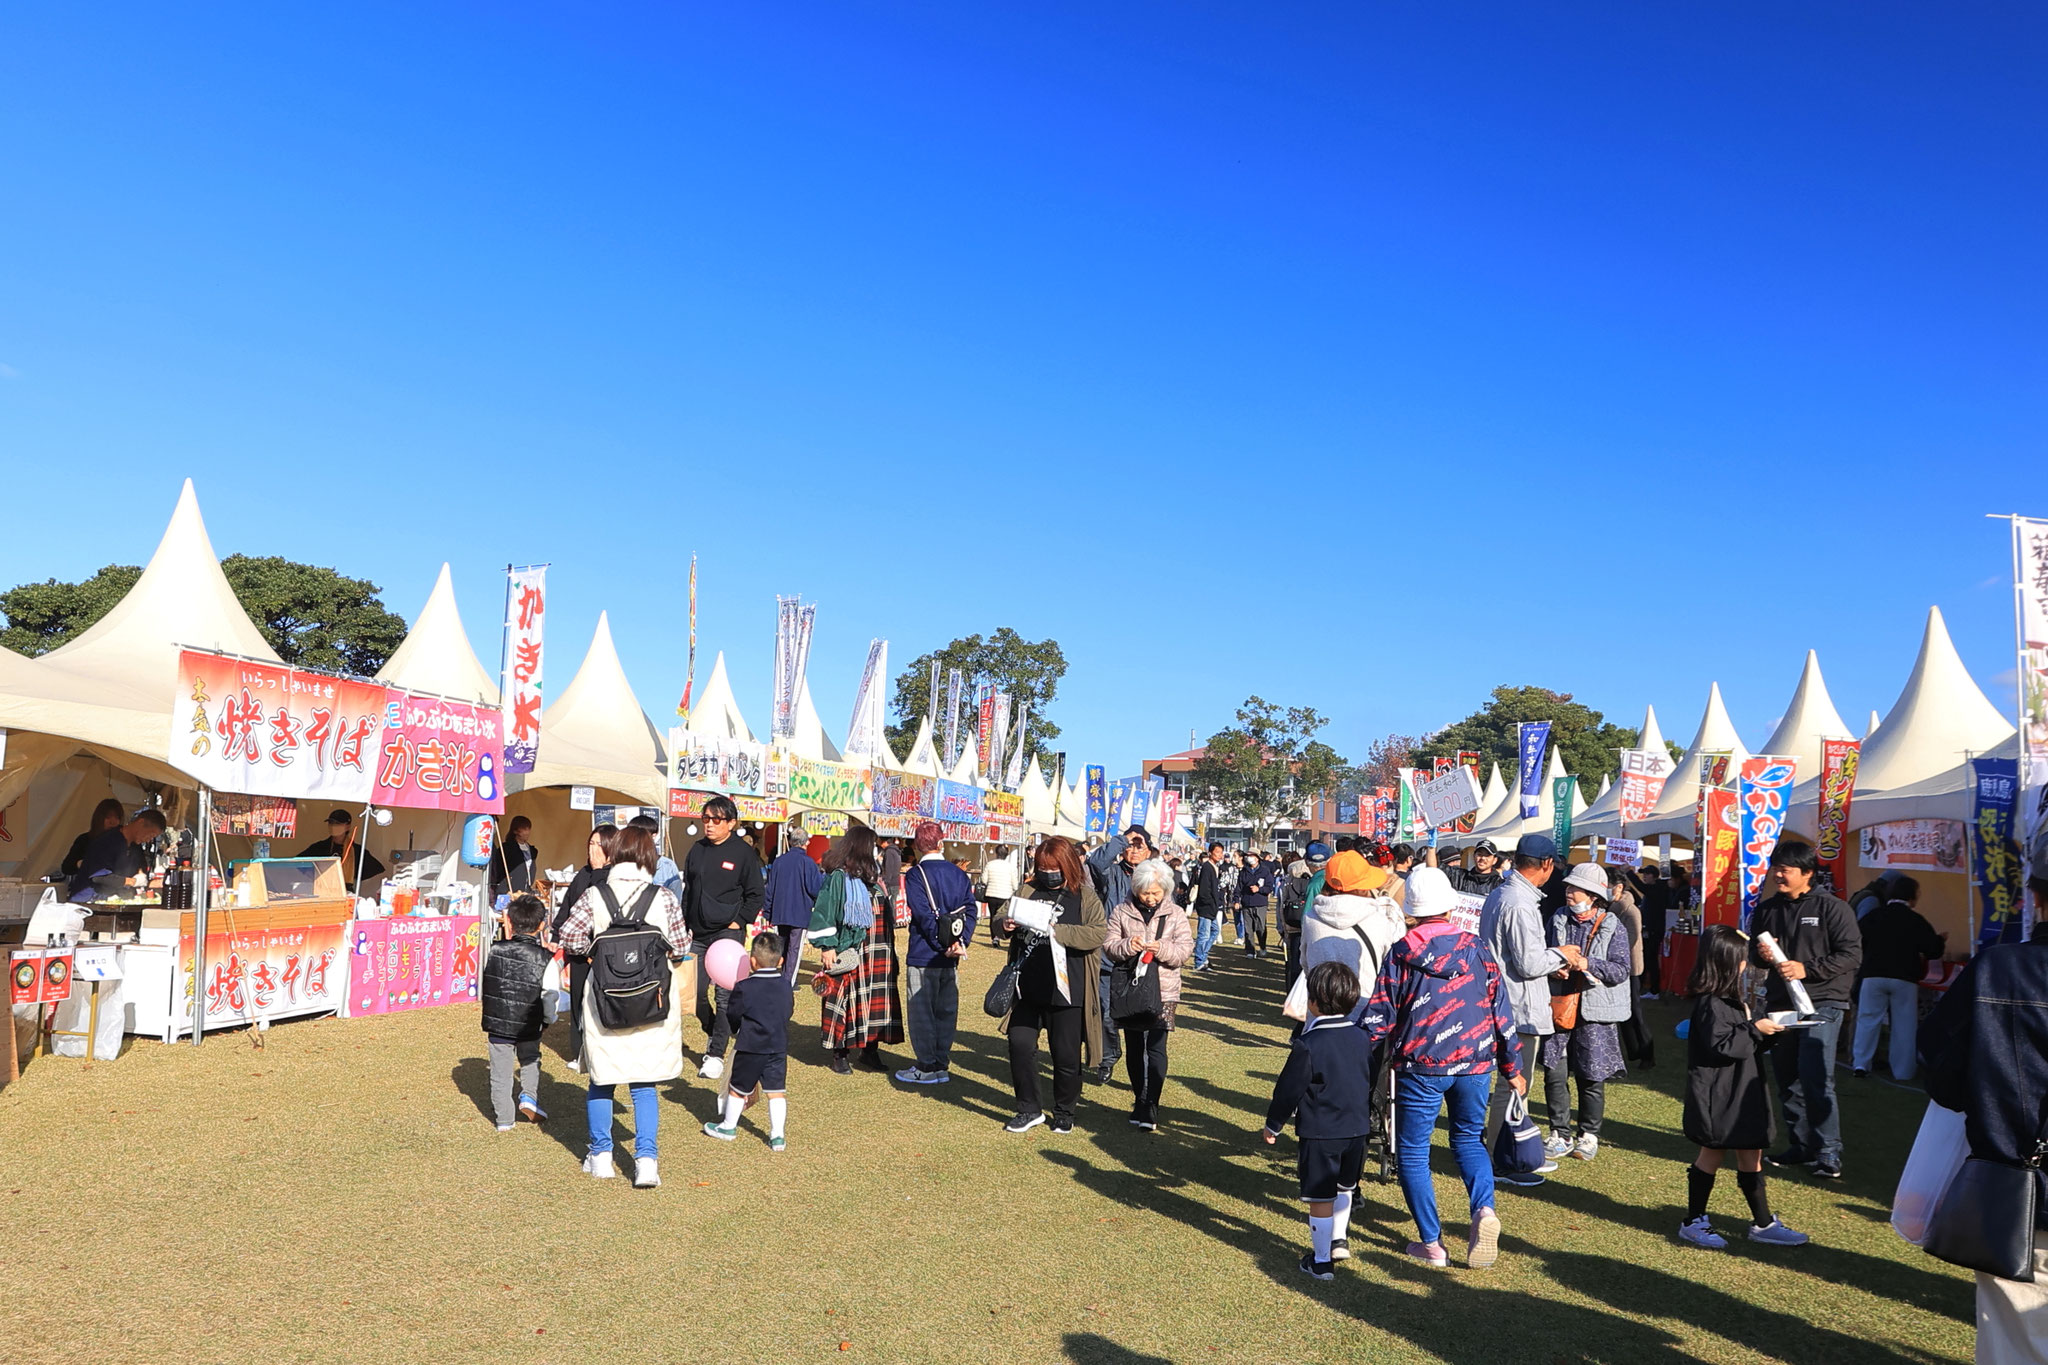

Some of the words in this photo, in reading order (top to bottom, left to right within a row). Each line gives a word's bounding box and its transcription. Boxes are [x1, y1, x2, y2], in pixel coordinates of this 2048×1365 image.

[512, 585, 544, 741] かき氷
[242, 671, 335, 699] いらっしゃいませ
[189, 676, 212, 757] 本気の
[215, 687, 378, 773] 焼きそば
[405, 705, 497, 740] ふわふわあまい氷
[380, 733, 476, 796] かき氷
[1426, 773, 1460, 800] 黒毛和牛
[1433, 791, 1462, 820] 500
[1162, 793, 1175, 832] クレープ
[1611, 853, 1635, 863] 開催中
[231, 933, 304, 951] いらっしゃいませ
[390, 919, 452, 935] ふわふわあまい氷
[376, 941, 387, 996] マンゴー
[387, 939, 399, 982] メロン
[401, 940, 411, 980] レモン
[205, 947, 337, 1016] 焼きそば
[1434, 1020, 1464, 1045] ADIDAS
